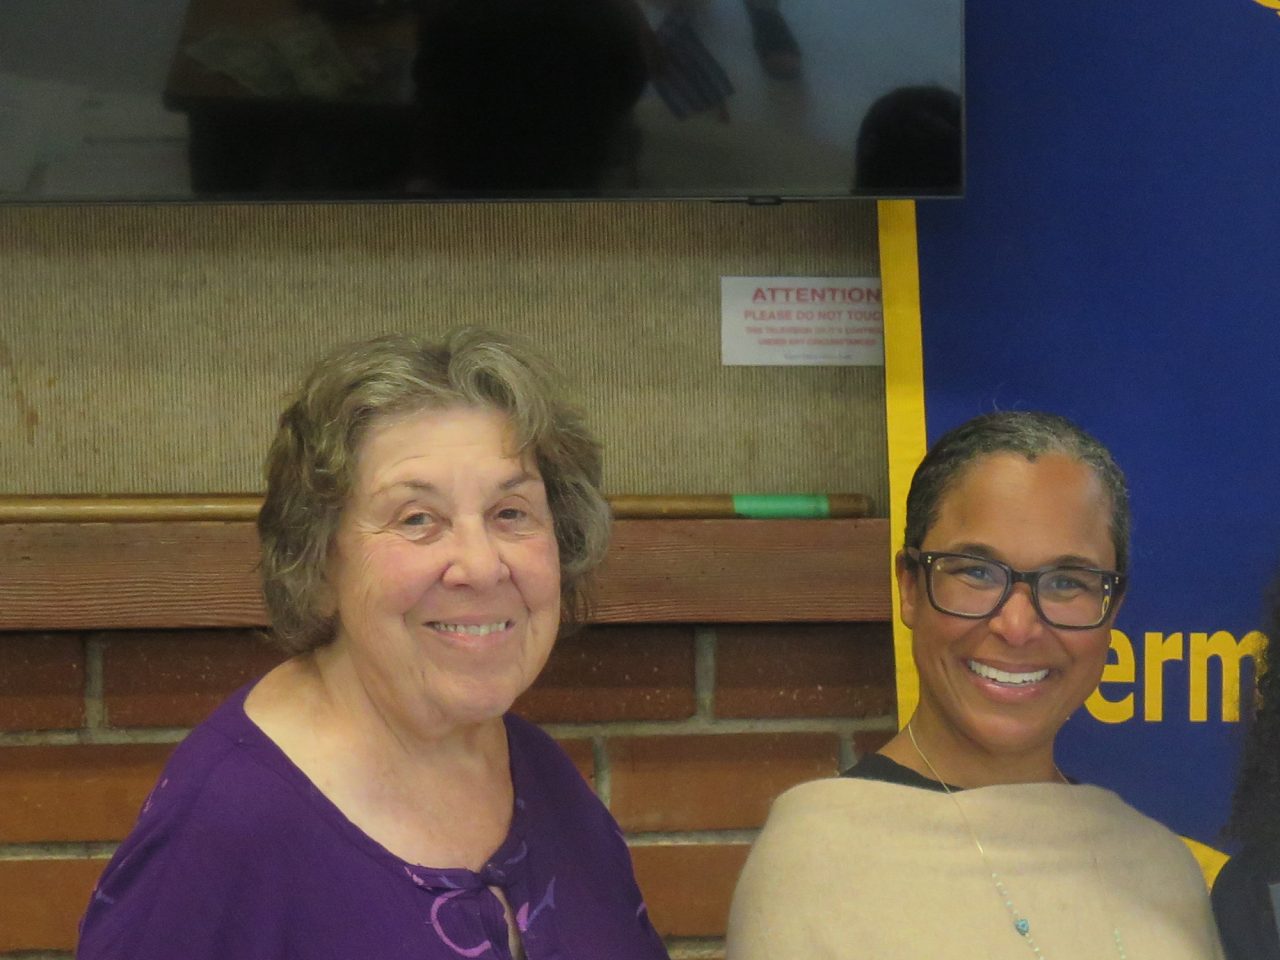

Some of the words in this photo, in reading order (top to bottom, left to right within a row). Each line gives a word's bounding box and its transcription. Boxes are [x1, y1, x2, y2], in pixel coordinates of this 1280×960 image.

[752, 287, 882, 303] ATTENTION
[744, 309, 792, 321] PLEASE
[796, 309, 815, 321] DO
[818, 309, 842, 321] NOT
[847, 309, 882, 322] TOUC
